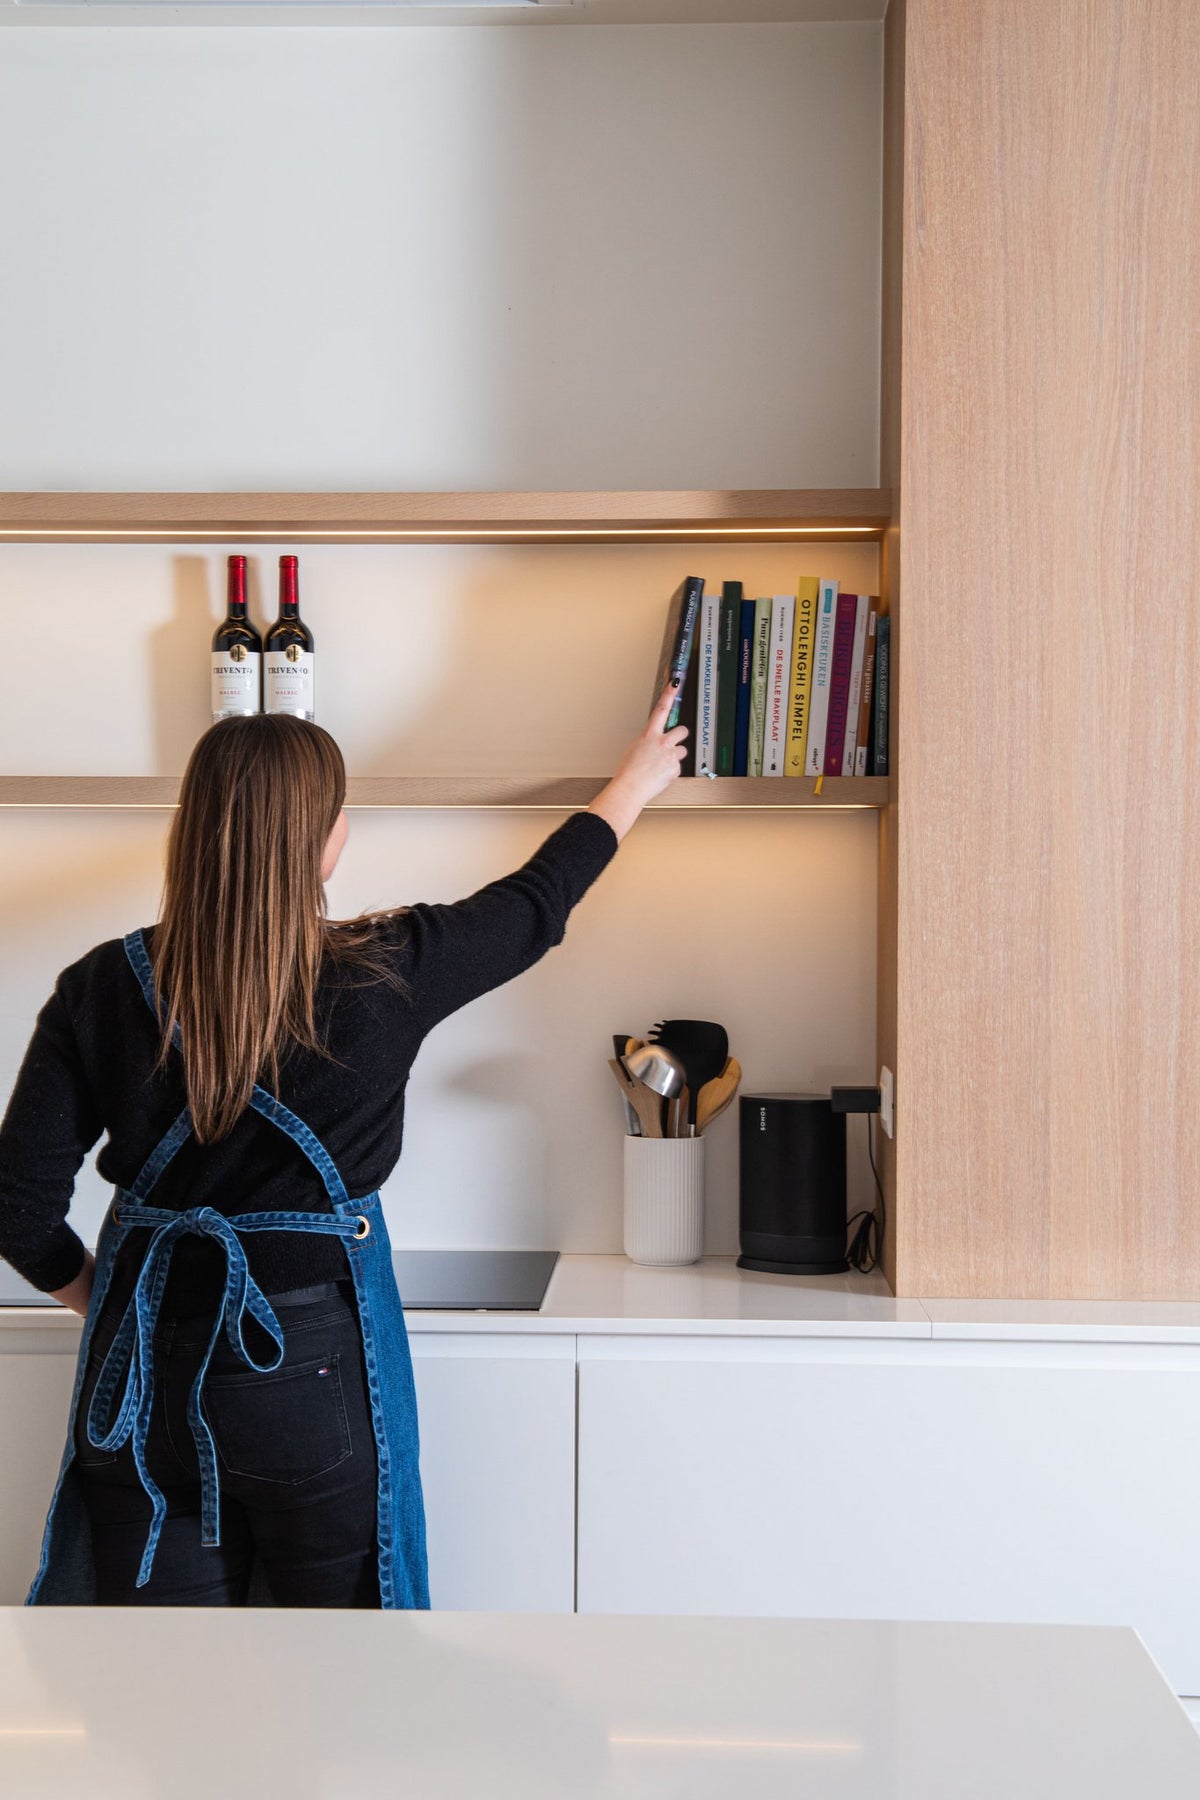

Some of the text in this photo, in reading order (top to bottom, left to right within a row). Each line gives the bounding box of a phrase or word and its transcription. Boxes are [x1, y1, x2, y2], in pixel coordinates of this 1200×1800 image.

[684, 607, 694, 632] PASCALE
[705, 644, 713, 655] DE
[758, 617, 769, 677] Puur genieten
[776, 649, 784, 662] DE
[817, 617, 831, 687] BASISKEUKEN
[268, 667, 308, 675] TRIVENO
[703, 656, 712, 704] MAKKELIJKE
[774, 663, 783, 696] SNELLE
[791, 599, 811, 742] OTTOLENGHI SIMPEL
[702, 706, 710, 746] BAKPLAAT
[771, 697, 781, 743] BAKPLAAT
